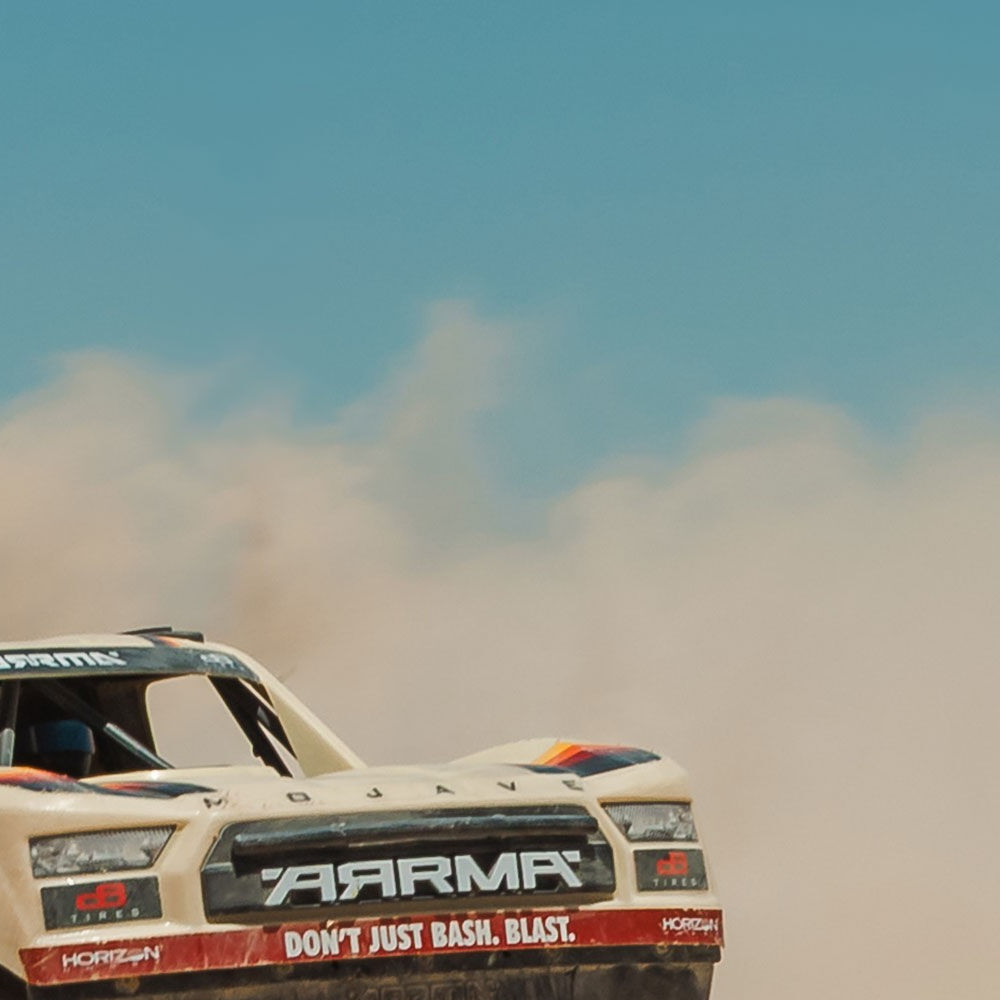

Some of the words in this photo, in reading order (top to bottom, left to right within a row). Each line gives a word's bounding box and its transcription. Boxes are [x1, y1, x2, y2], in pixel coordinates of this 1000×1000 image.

[261, 850, 583, 907] ARRMA
[70, 907, 141, 924] TIRES
[284, 927, 361, 959] DON'T
[368, 922, 424, 954] JUST
[431, 918, 500, 949] BASH.
[504, 915, 576, 945] BLAST.
